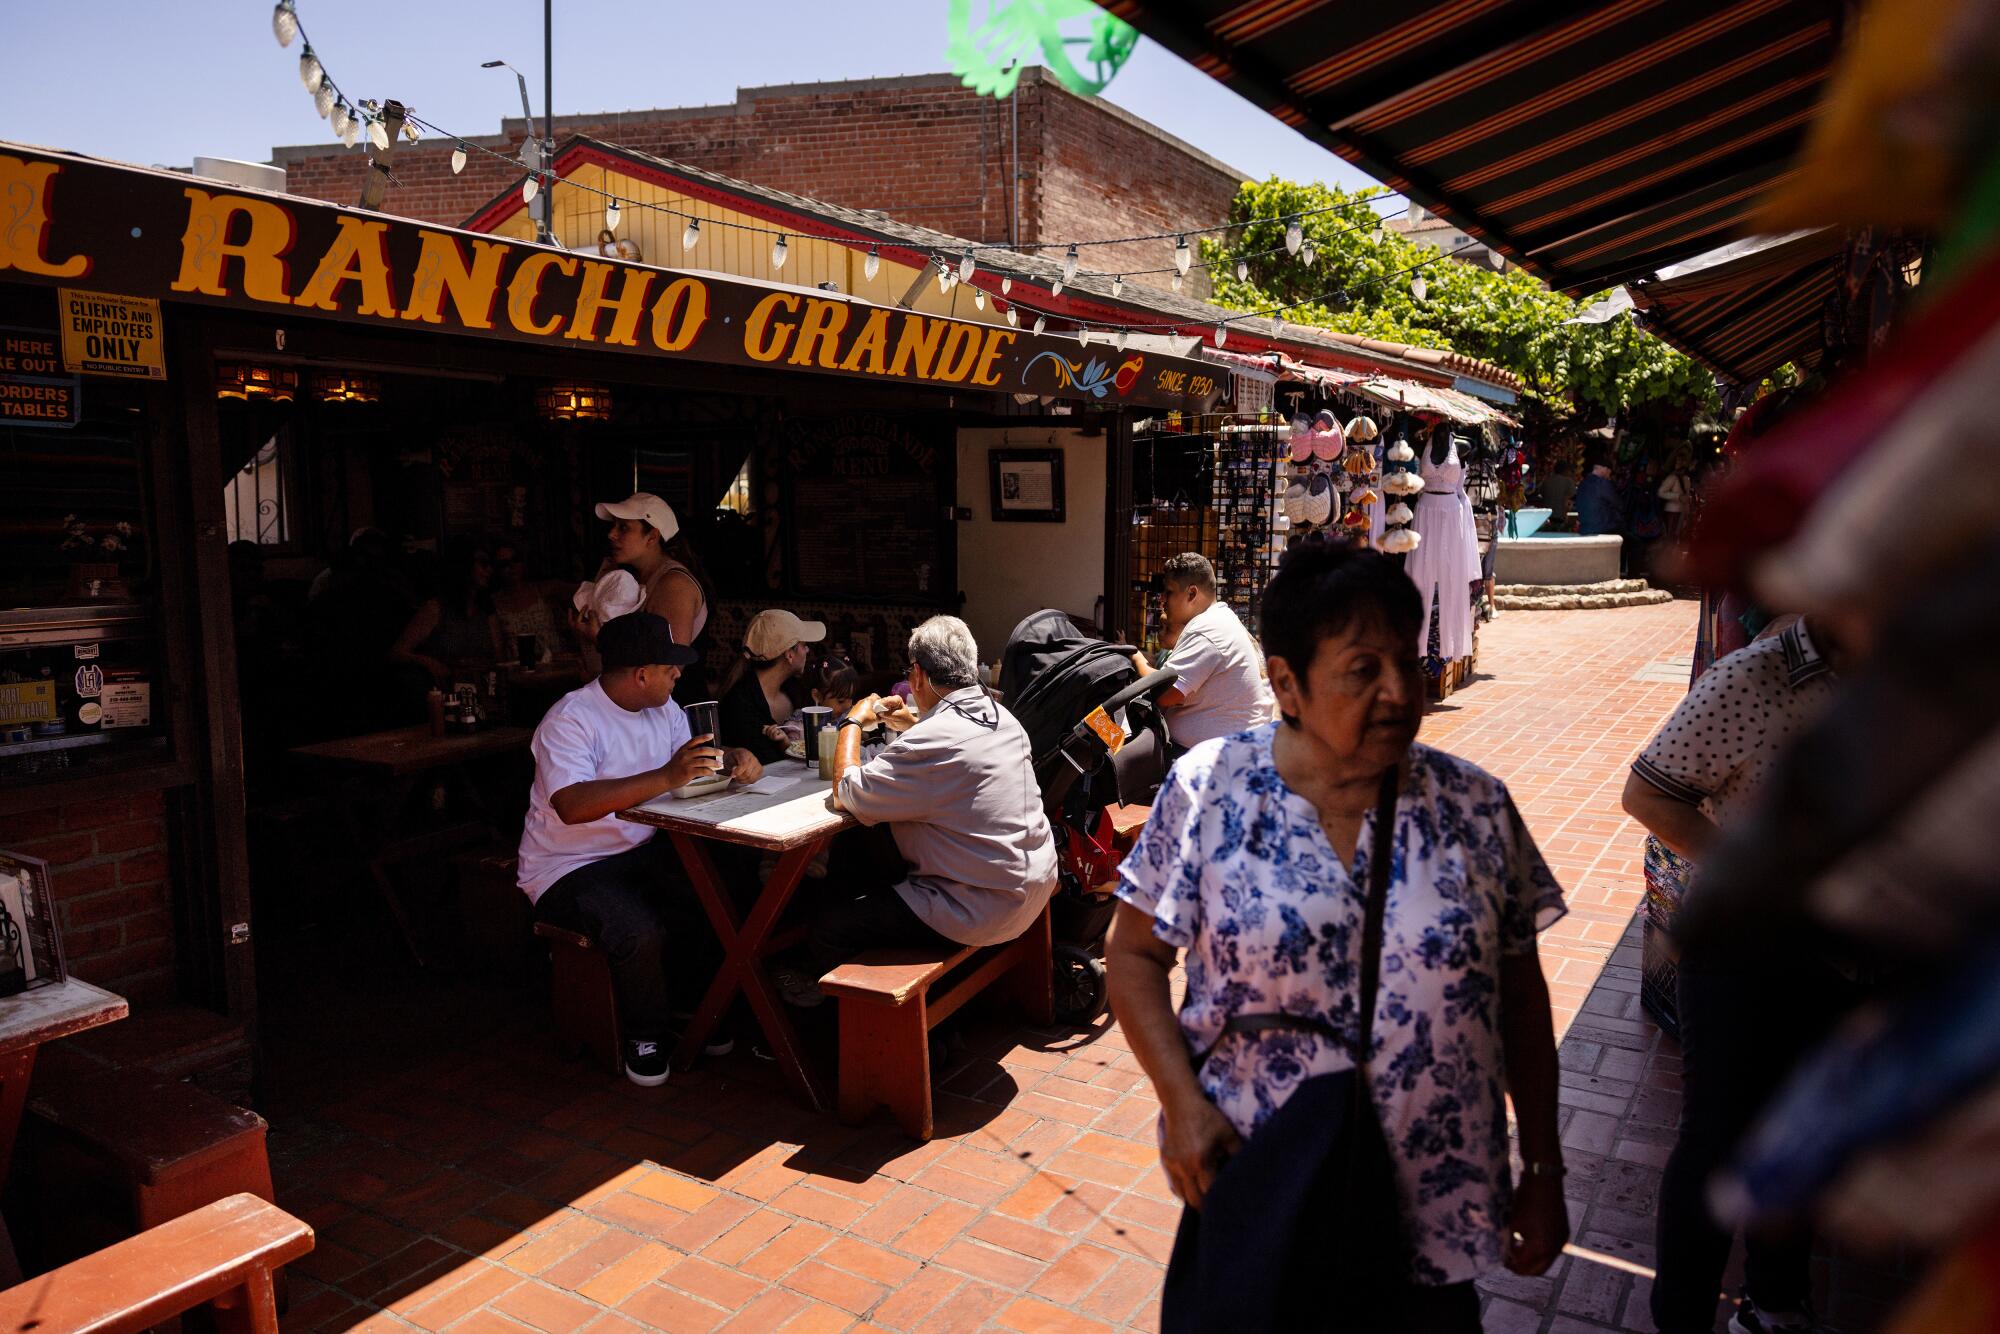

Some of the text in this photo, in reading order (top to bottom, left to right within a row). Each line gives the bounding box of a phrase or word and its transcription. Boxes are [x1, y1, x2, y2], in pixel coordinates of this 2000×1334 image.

[171, 188, 710, 352] RANCHO
[744, 292, 1017, 387] GRANDE
[70, 300, 152, 323] CLIENTS AND
[73, 317, 153, 340] EMPLOYEES
[6, 338, 55, 356] HERE
[86, 335, 140, 362] ONLY
[21, 358, 57, 373] OUT
[97, 363, 122, 372] PUBLIC
[123, 365, 145, 374] ENTRY
[1157, 369, 1213, 396] SINCE 1930
[0, 384, 69, 403] ORDERS
[1, 401, 69, 418] TABLES
[832, 456, 890, 475] MENU
